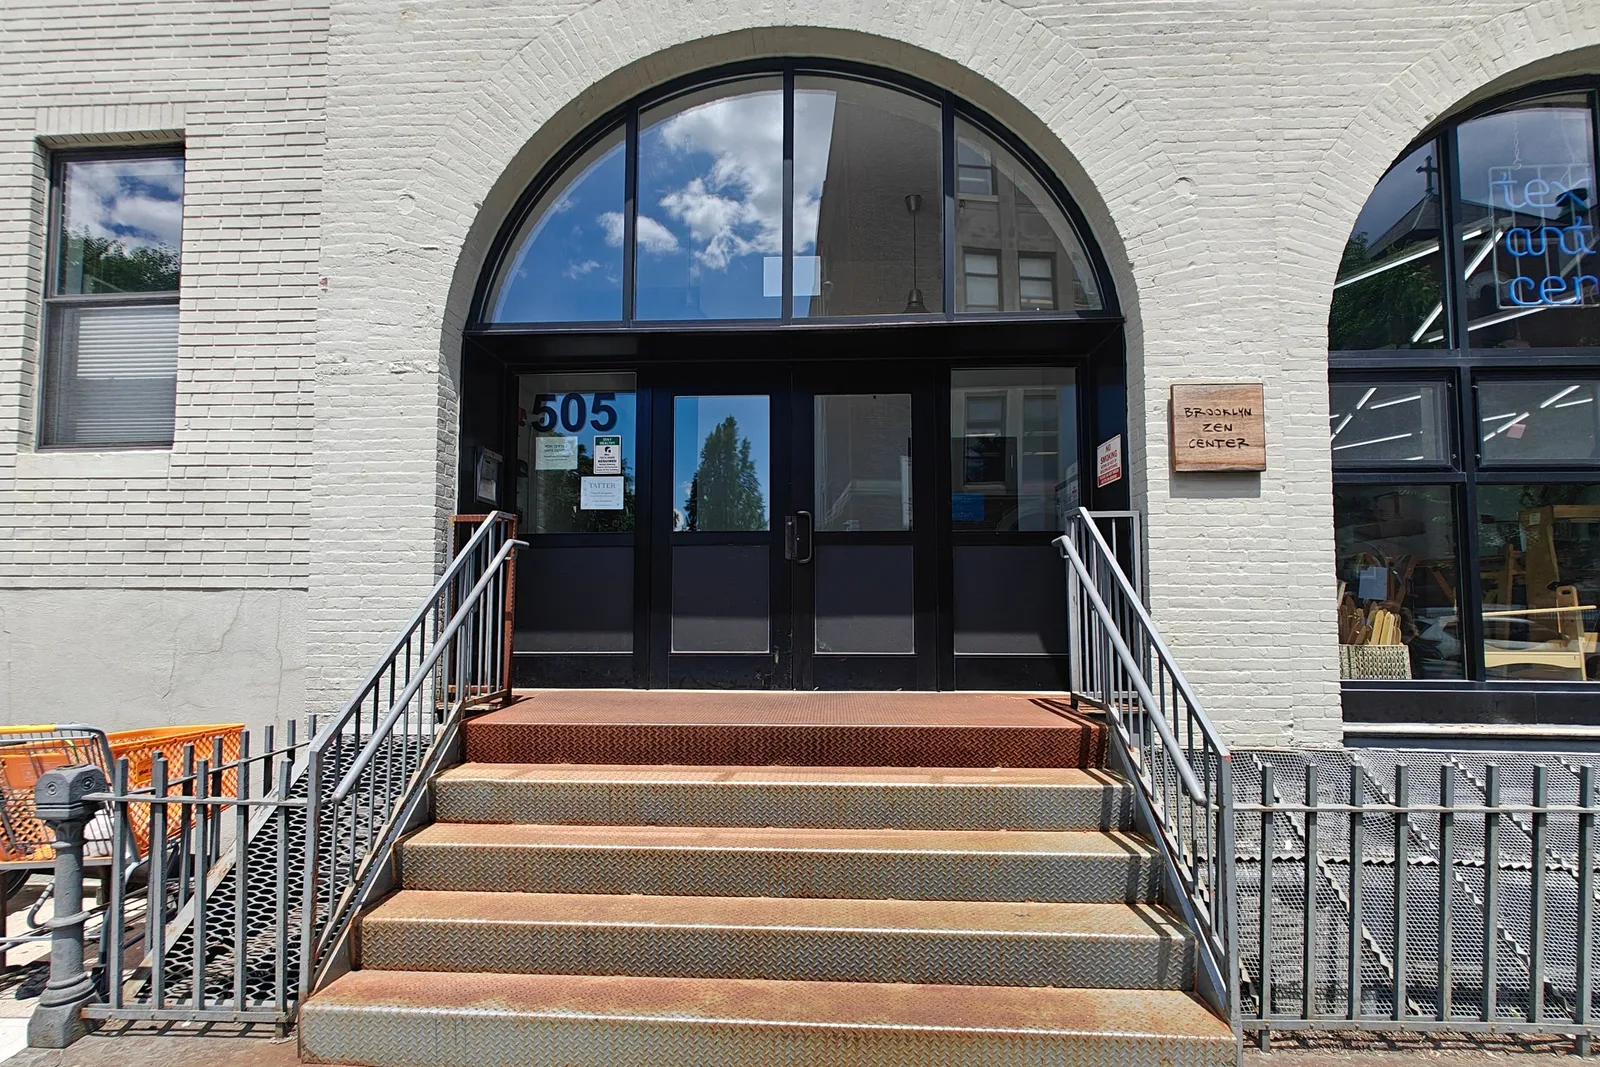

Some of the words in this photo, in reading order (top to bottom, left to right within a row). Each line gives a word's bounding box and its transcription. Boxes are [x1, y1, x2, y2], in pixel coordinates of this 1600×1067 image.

[531, 392, 618, 433] 505
[1184, 407, 1252, 418] BROOKLYN
[1202, 423, 1233, 432] ZEN
[1105, 443, 1112, 453] NO
[1188, 438, 1250, 449] CENTER
[1100, 449, 1118, 465] SMOKING
